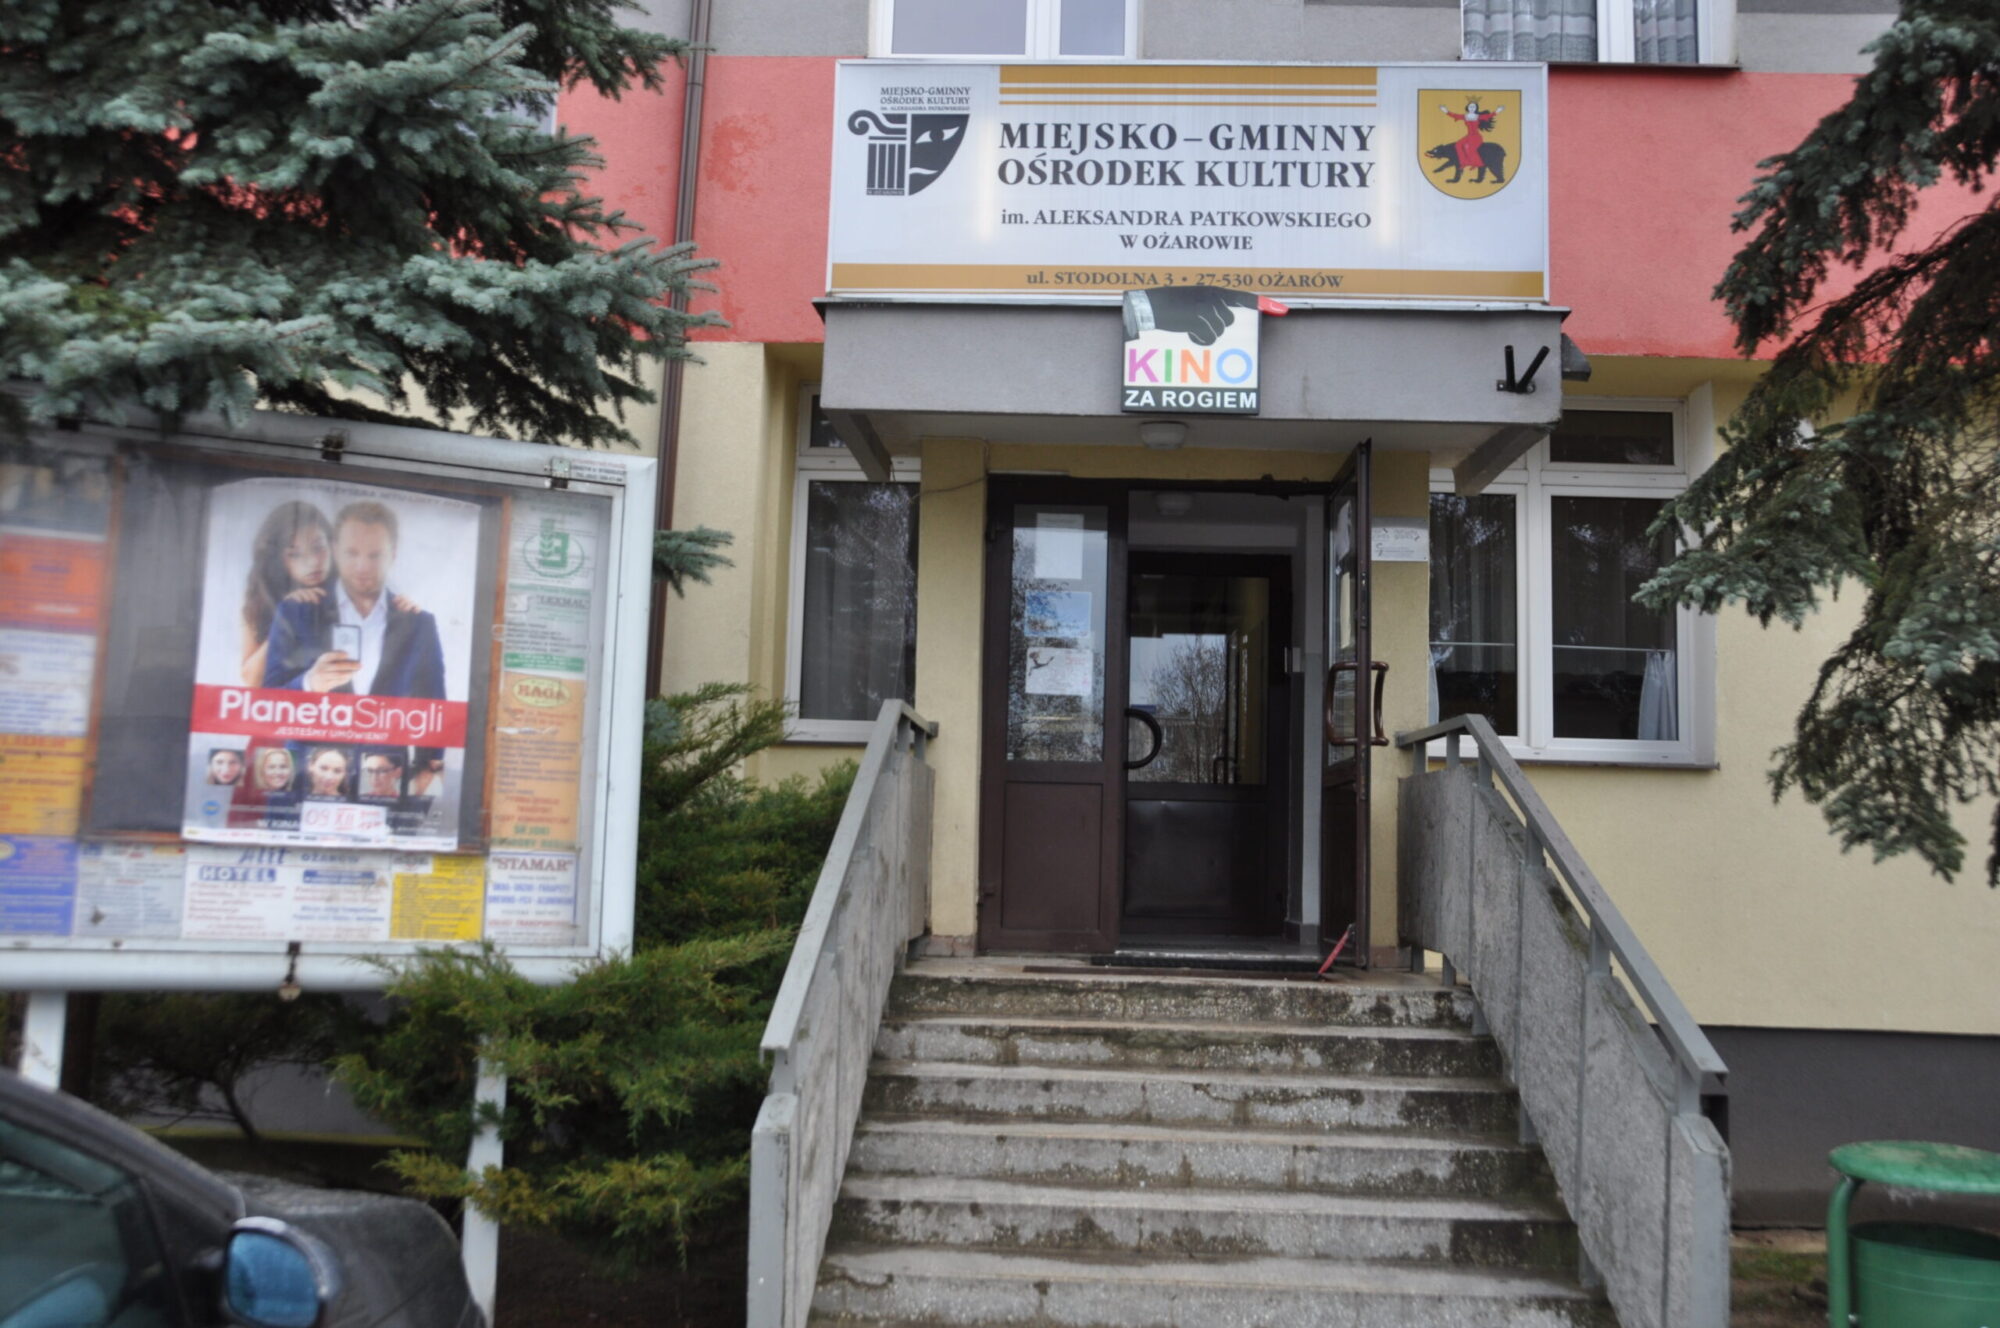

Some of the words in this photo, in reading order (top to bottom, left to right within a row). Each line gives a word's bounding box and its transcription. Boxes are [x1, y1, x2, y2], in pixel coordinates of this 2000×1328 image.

[926, 97, 970, 105] KULTURY
[998, 152, 1186, 186] OŚRODEK
[1195, 160, 1375, 188] KULTURY
[1001, 209, 1029, 225] im.
[1033, 209, 1184, 226] ALEKSANDRA
[1190, 211, 1371, 228] PATKOWSKIEGO
[1119, 234, 1138, 249] W
[1143, 231, 1253, 250] OŻAROWIE
[1026, 271, 1049, 284] ul.
[1054, 271, 1159, 285] STODOLNA
[1164, 272, 1174, 286] 3
[1196, 273, 1253, 288] 27-530
[1258, 271, 1343, 288] OŻARÓW
[1128, 348, 1253, 384] KINO
[1125, 390, 1155, 407] ZA
[1162, 390, 1256, 408] ROGIEM
